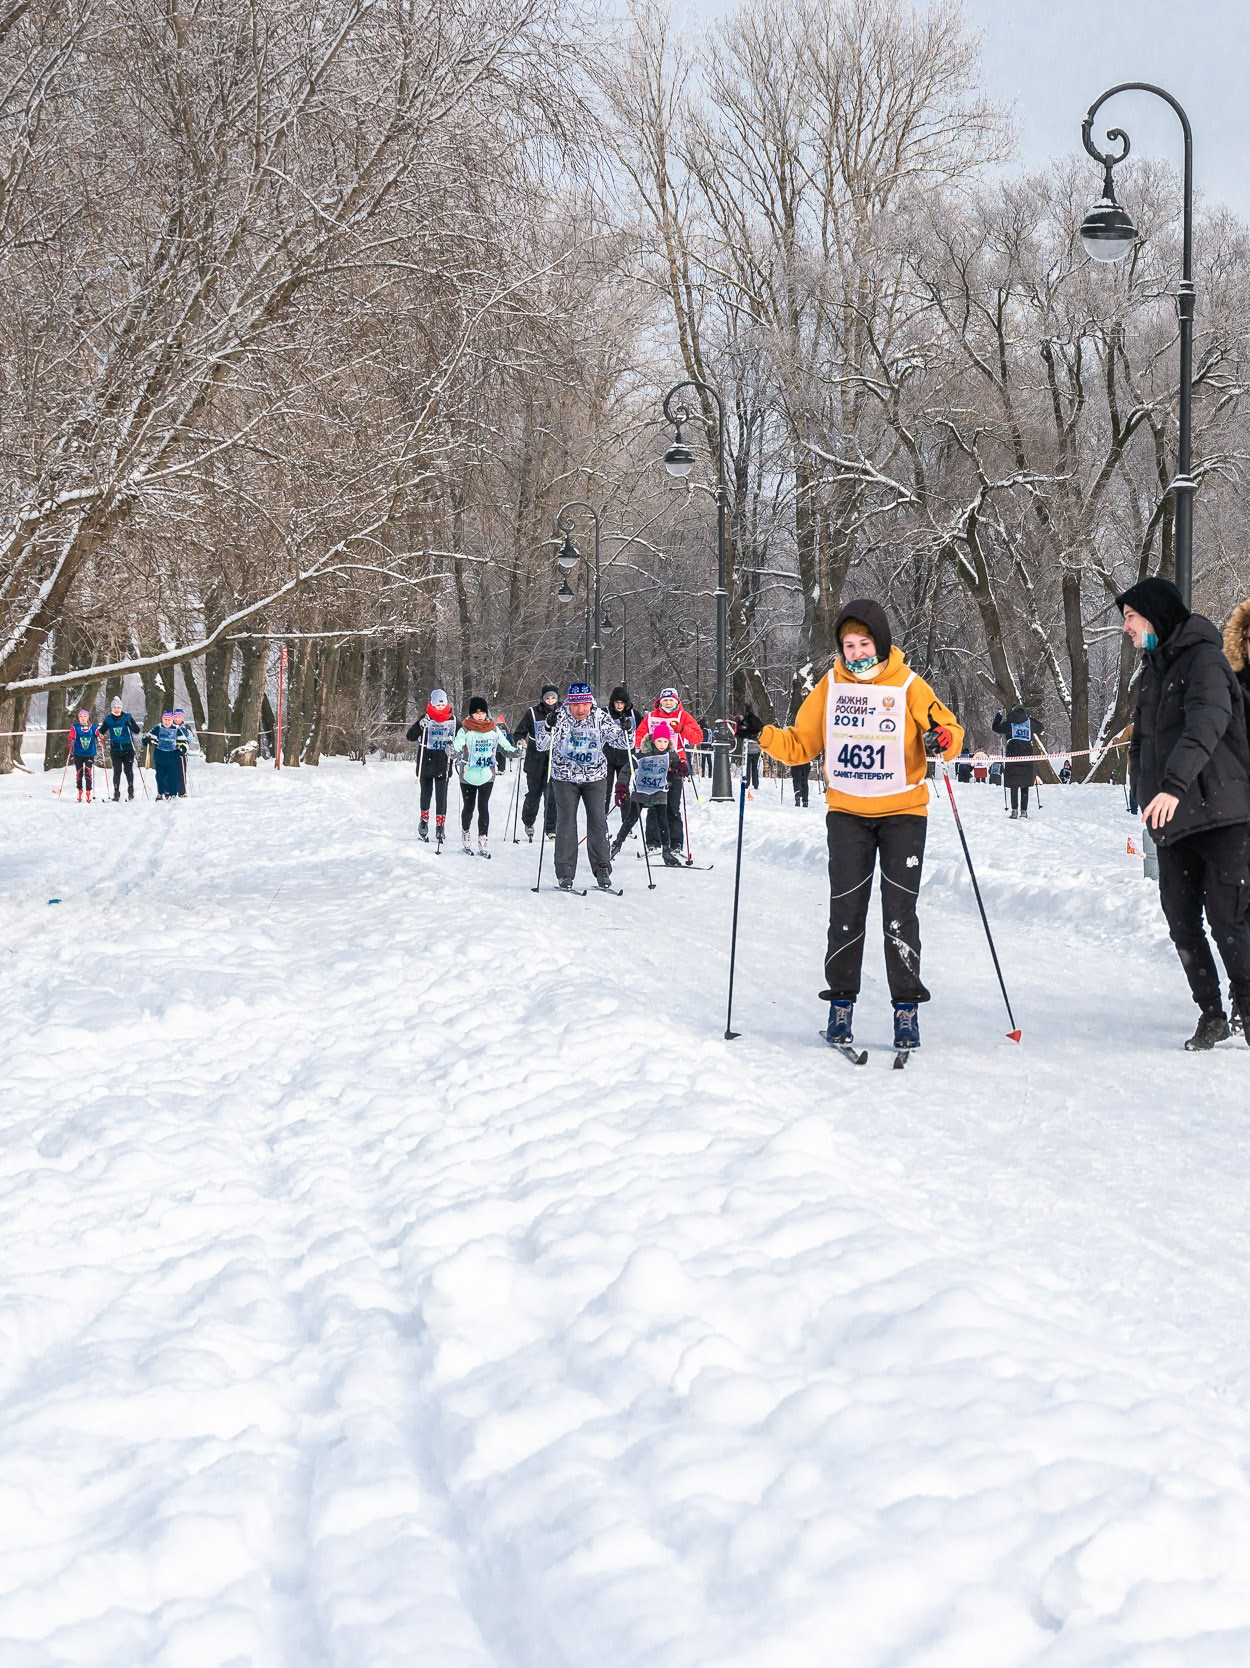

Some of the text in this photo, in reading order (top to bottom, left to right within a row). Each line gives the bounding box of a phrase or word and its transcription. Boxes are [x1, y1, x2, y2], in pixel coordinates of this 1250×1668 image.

[836, 695, 868, 705] ЛЫЖНЯ
[835, 705, 868, 715] РОССИИ
[834, 715, 865, 727] 2021
[432, 740, 448, 750] 415
[838, 744, 885, 769] 4631
[834, 770, 894, 780] САНКТ-ПЕТЕРБУРГ
[642, 776, 662, 787] 4547
